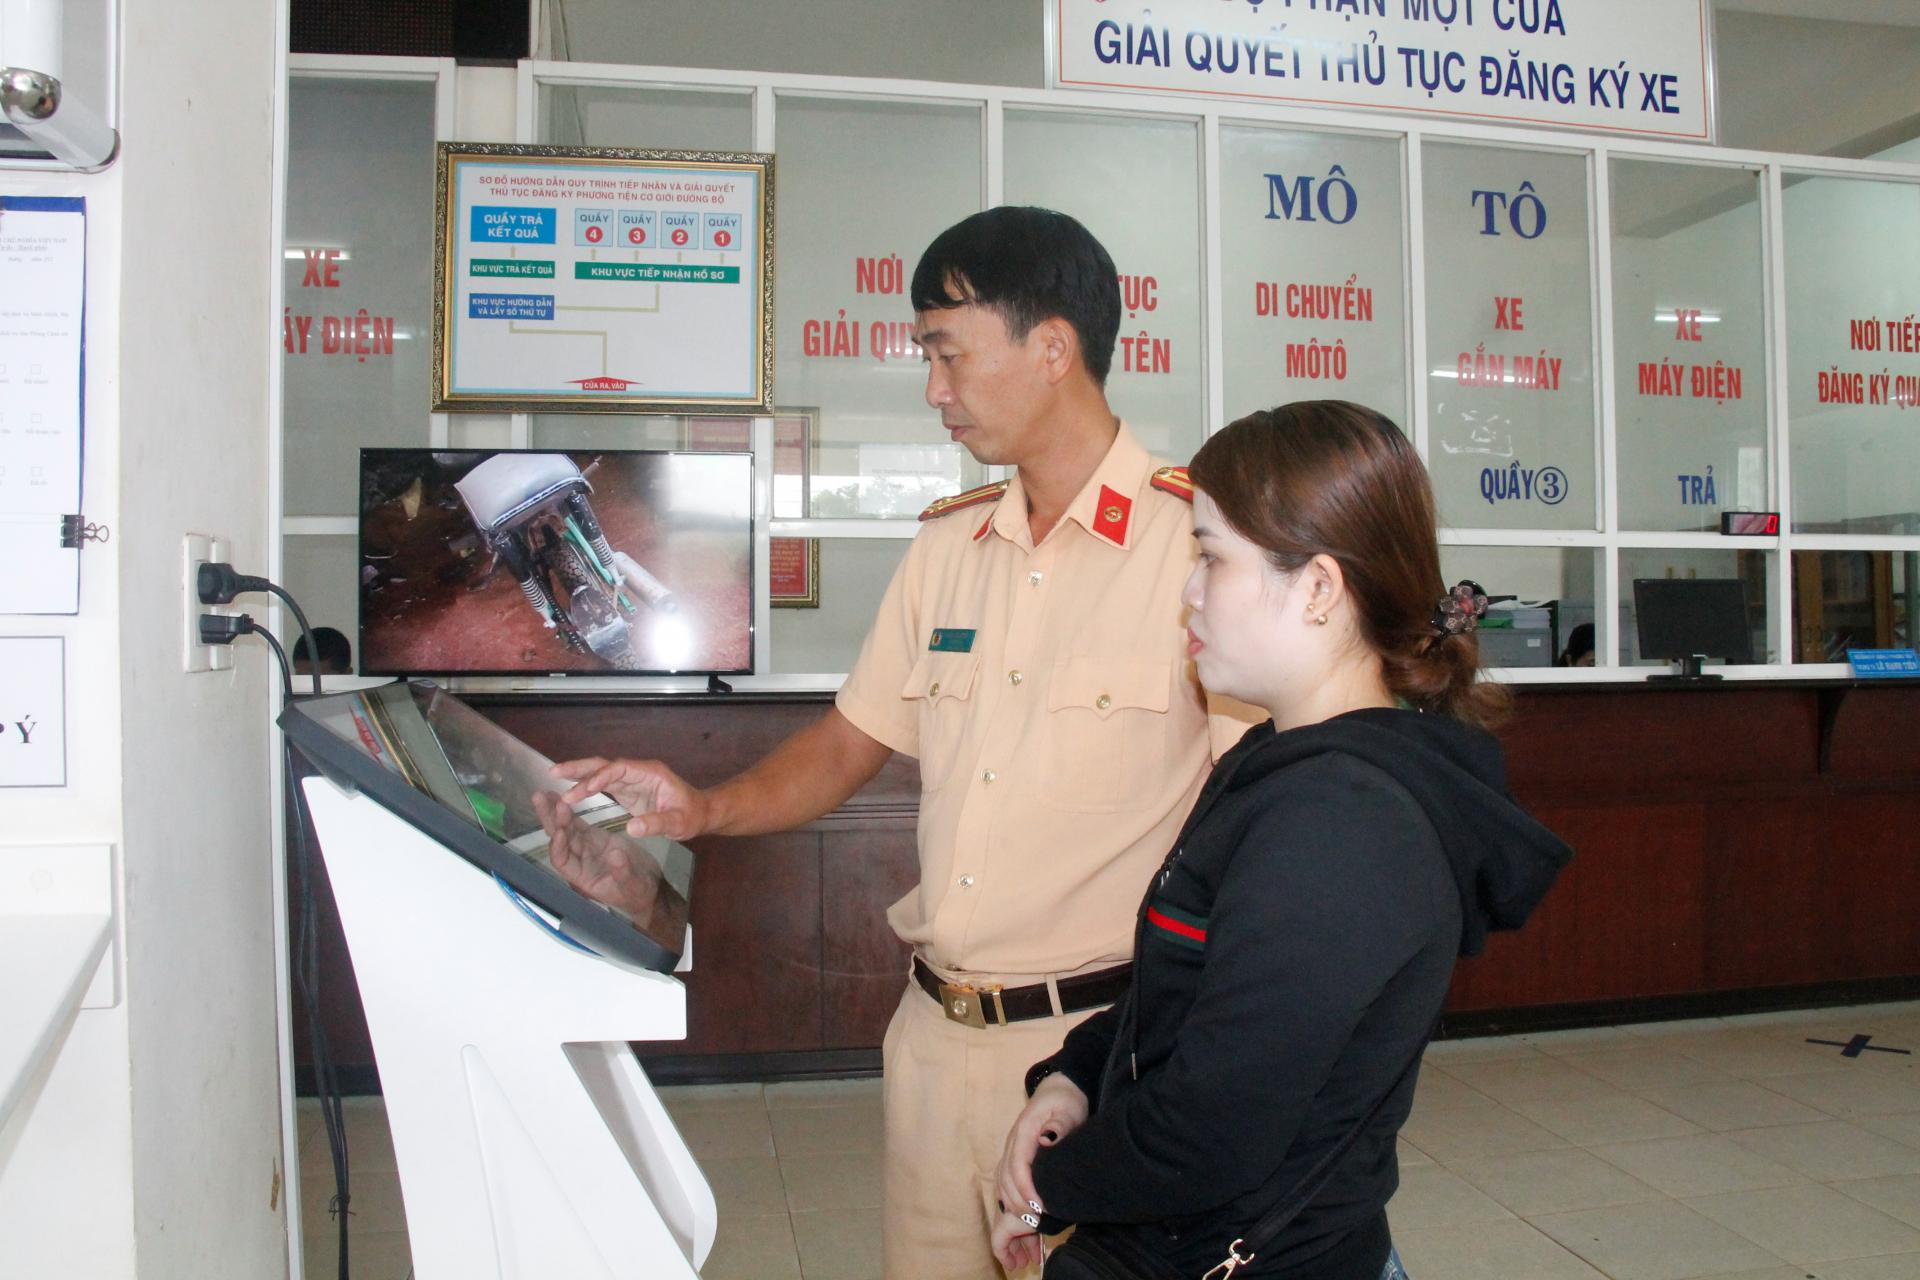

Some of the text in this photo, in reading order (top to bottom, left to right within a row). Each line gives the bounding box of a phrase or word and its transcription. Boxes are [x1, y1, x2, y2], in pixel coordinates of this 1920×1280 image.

[1094, 8, 1680, 114] GIẢI QUYẾT THỦ TỤC ĐĂNG KÝ XE
[1263, 164, 1547, 240] MÔ TÔ
[589, 228, 598, 239] 4
[632, 230, 642, 241] 3
[676, 232, 684, 242] 2
[302, 248, 341, 288] XE
[591, 267, 612, 276] KHU
[855, 252, 903, 295] NƠI
[1255, 273, 1373, 322] DI CHUYỂN
[1494, 296, 1525, 331] XE
[321, 307, 394, 363] ĐIỆN
[803, 309, 860, 358] GIẢI
[1675, 308, 1703, 342] XE
[1850, 315, 1881, 352] NƠI
[1120, 331, 1171, 374] TÊN
[1286, 337, 1347, 381] MÔTÔ
[1457, 341, 1563, 391] GẮN MÁY
[1638, 356, 1742, 405] MÁY ĐIỆN
[1818, 365, 1864, 405] ĐĂNG
[1869, 367, 1890, 406] KÝ
[1480, 459, 1534, 505] QUẦY
[1677, 465, 1717, 505] TRẢ
[15, 714, 38, 744] Ý
